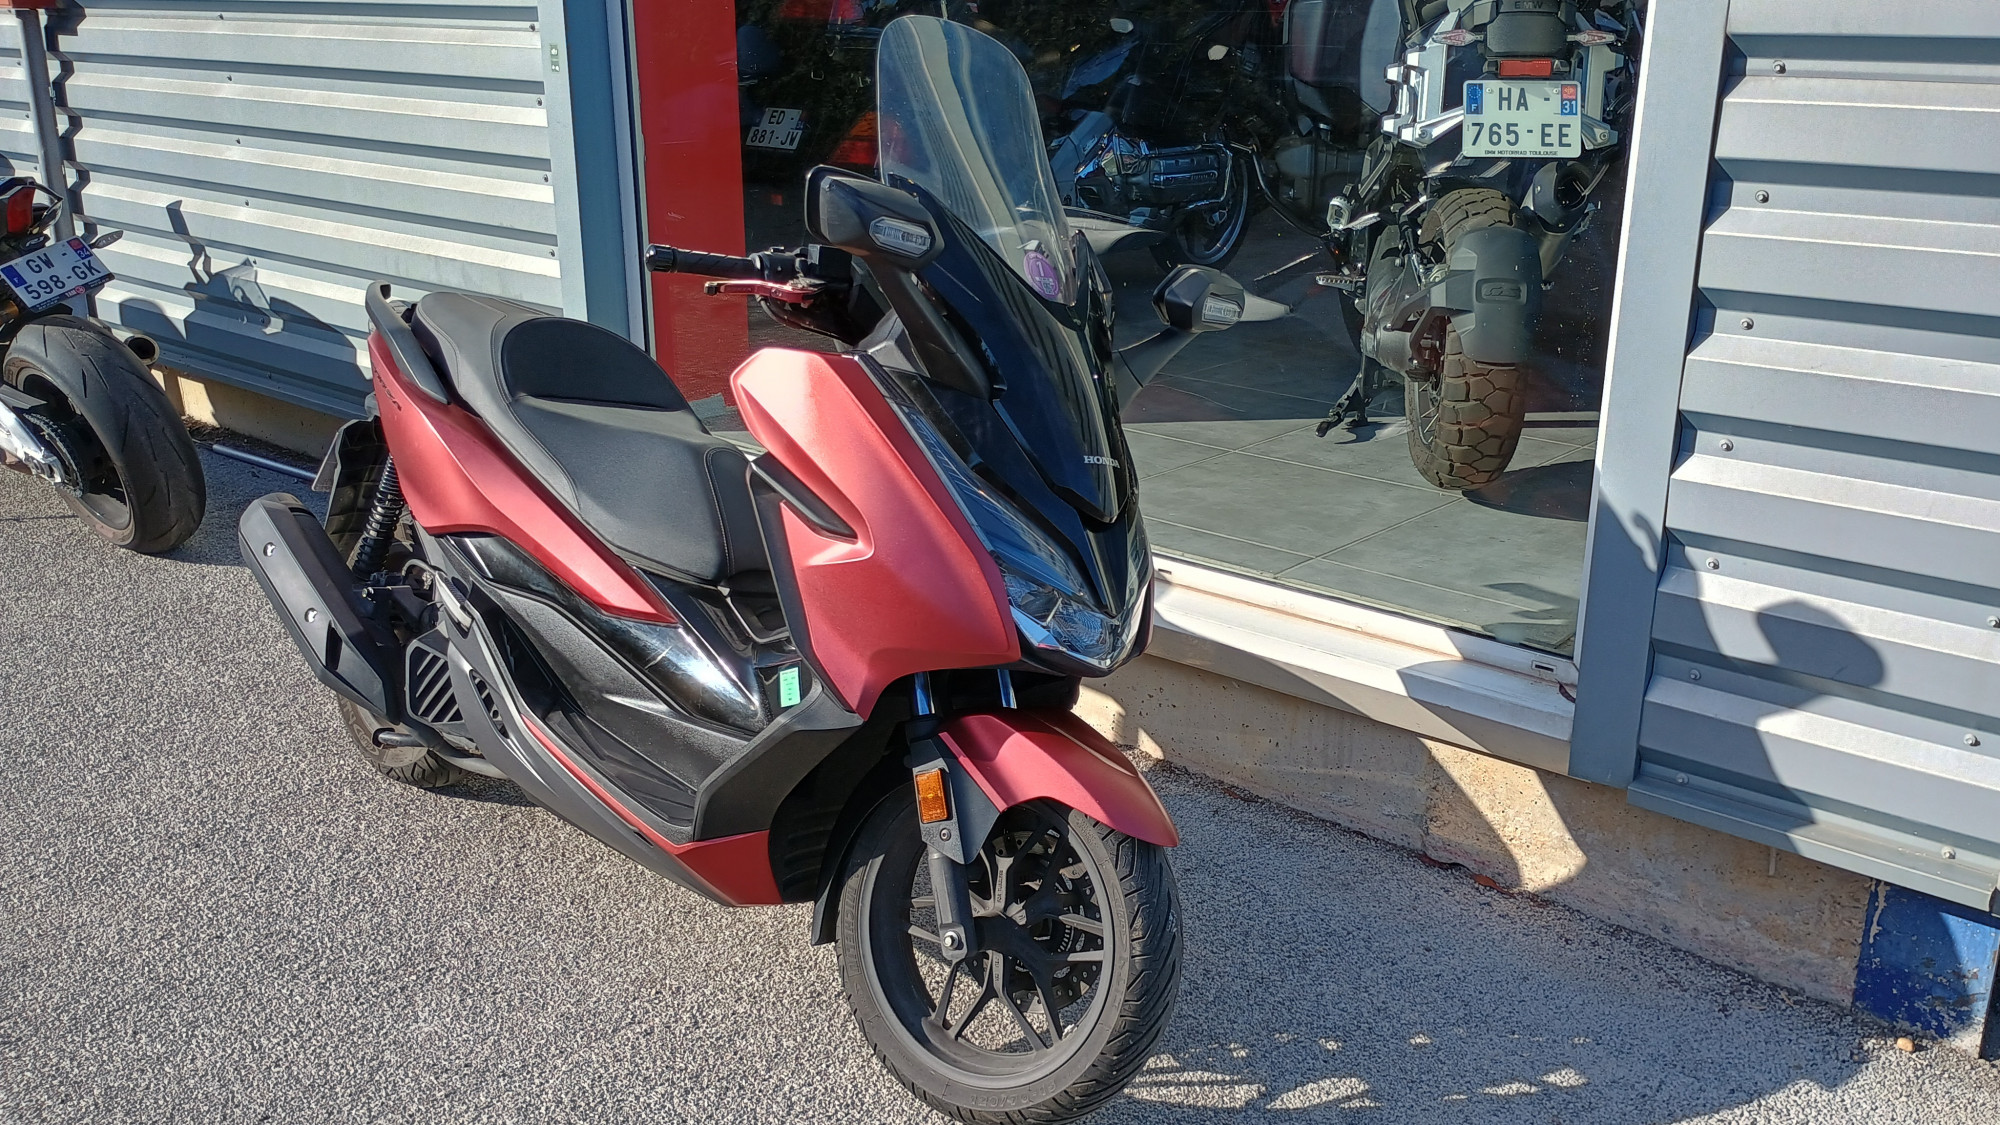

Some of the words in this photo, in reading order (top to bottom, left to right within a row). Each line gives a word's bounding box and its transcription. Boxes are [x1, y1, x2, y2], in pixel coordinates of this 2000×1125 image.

[1471, 103, 1478, 112] F
[1498, 87, 1529, 111] HA
[1562, 100, 1577, 114] 31
[768, 109, 786, 125] ED
[1471, 122, 1572, 148] 765-EE
[25, 252, 55, 275] GW
[77, 249, 91, 259] 34
[24, 259, 102, 300] 598-GK
[1083, 455, 1121, 469] HONDA
[844, 884, 861, 974] MICHELIN
